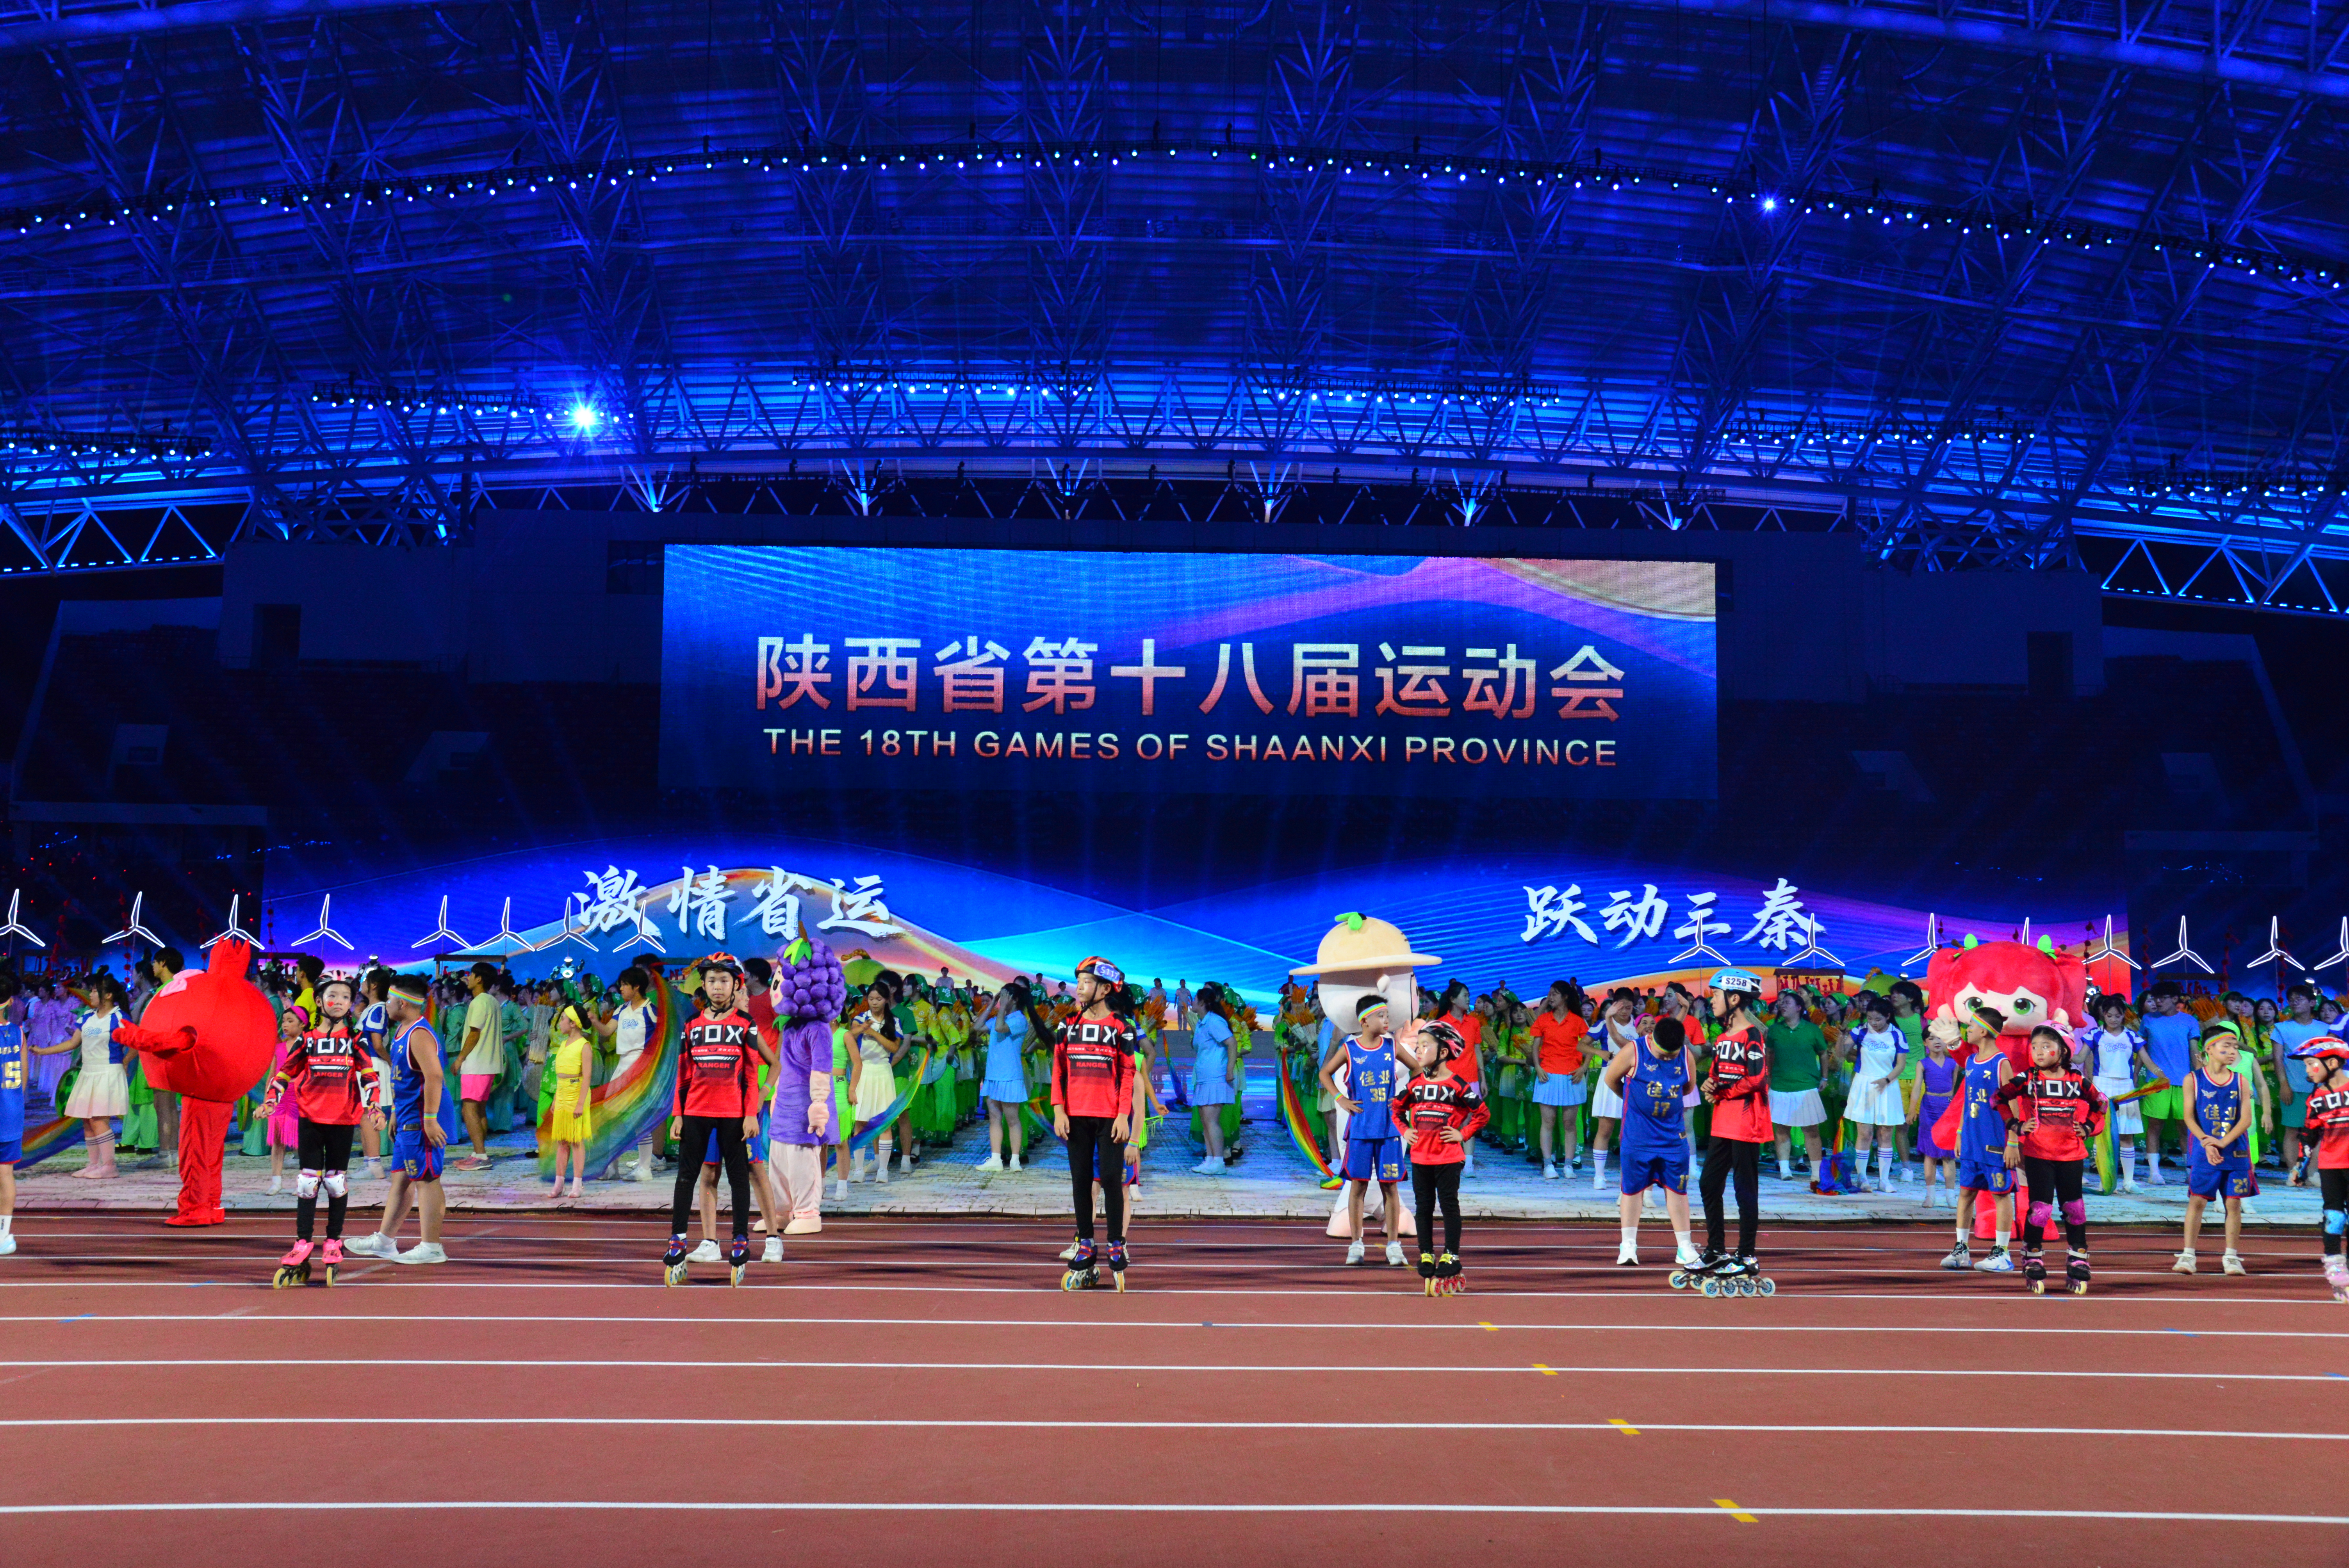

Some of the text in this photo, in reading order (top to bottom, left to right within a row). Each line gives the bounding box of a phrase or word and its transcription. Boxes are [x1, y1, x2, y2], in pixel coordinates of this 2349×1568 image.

[756, 633, 1625, 722] 陕西省第十八届运动会
[763, 729, 1616, 766] THE 18TH GAMES OF SHAANXI PROVINCE
[572, 865, 911, 942] 激情省运
[1520, 878, 1827, 950] 跃动三秦
[1100, 966, 1118, 979] S117
[1725, 977, 1747, 987] S258
[690, 1025, 743, 1046] FOX
[1067, 1024, 1117, 1045] FOX
[1359, 1069, 1390, 1087] 佳业
[1370, 1087, 1386, 1102] 35
[1412, 1084, 1456, 1102] FOX
[1647, 1080, 1680, 1099] 佳业
[1652, 1101, 1670, 1117] 17
[2203, 1104, 2237, 1121] 佳业
[2212, 1121, 2231, 1137] 23
[1383, 1164, 1399, 1178] 35
[1991, 1172, 2005, 1188] 18
